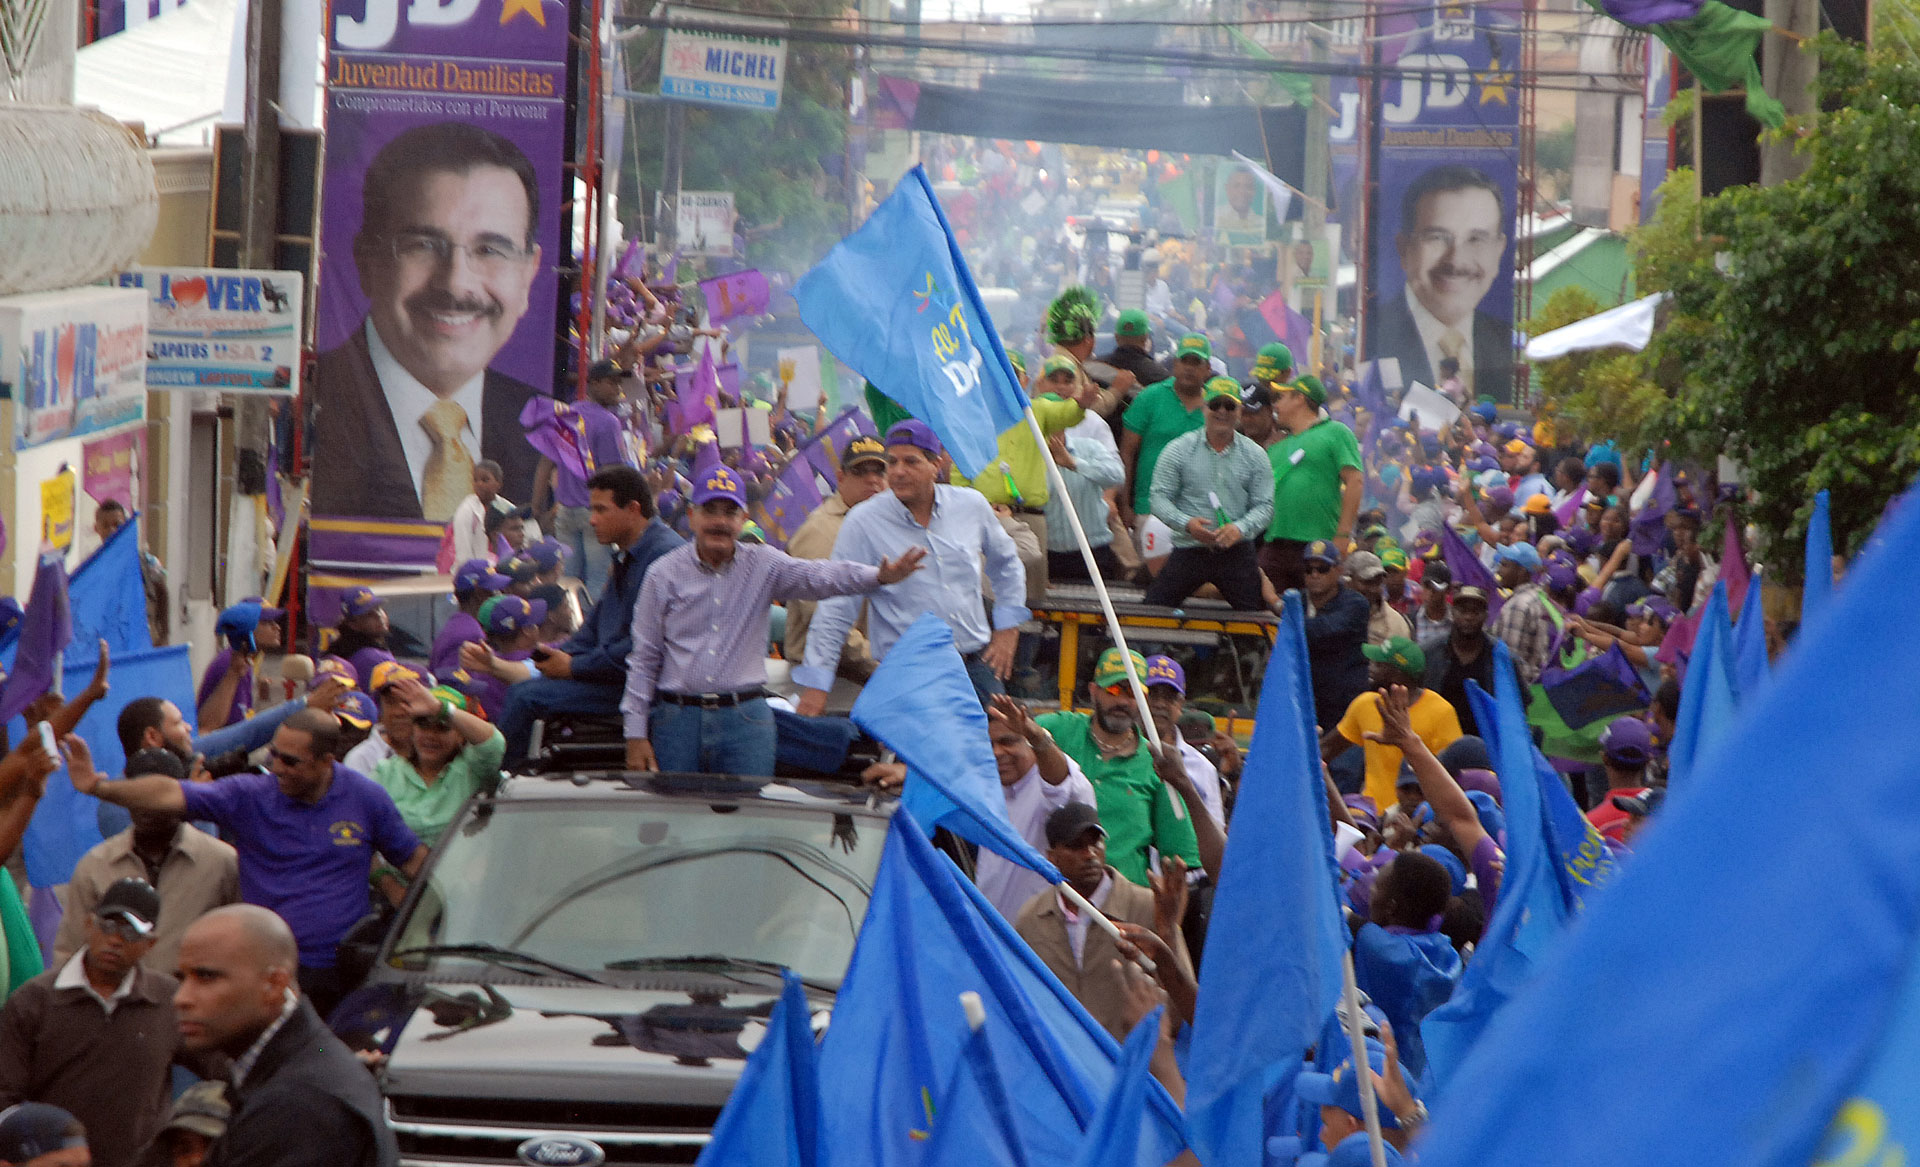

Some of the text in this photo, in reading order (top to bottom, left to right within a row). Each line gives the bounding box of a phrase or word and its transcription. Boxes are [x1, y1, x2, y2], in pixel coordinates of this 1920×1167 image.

[333, 56, 554, 96] Juventud Danilistas
[705, 47, 776, 80] MICHEL
[1383, 54, 1471, 123] JD
[335, 93, 548, 119] Comprometidos con el Porvenir
[706, 476, 737, 493] PLD
